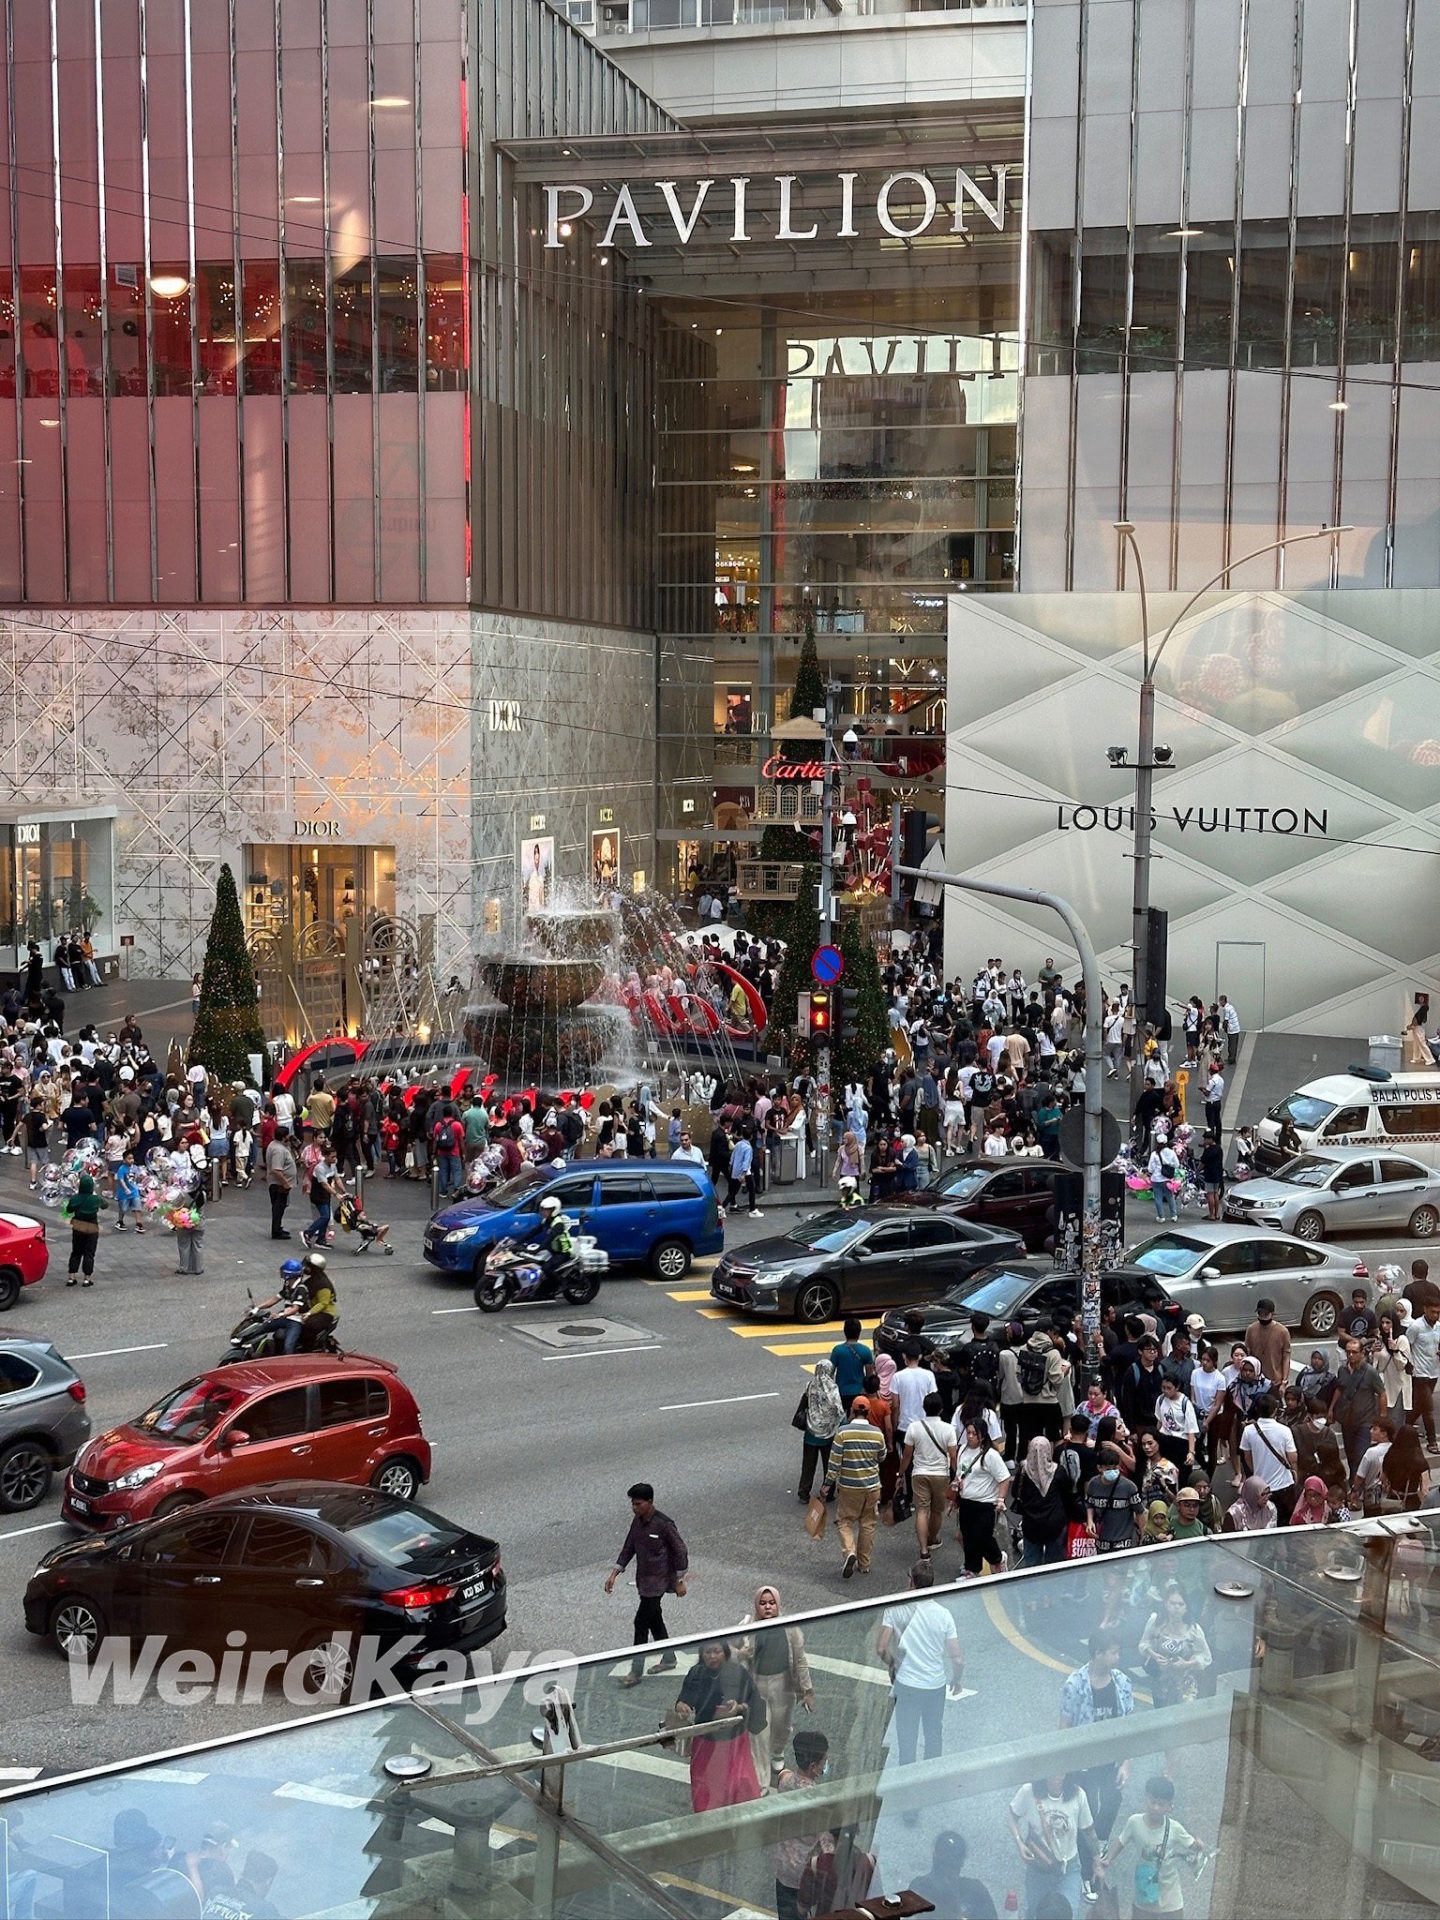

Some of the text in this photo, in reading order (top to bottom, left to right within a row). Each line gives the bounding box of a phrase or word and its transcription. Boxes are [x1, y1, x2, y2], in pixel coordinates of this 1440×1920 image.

[542, 164, 1010, 248] PAVILION
[294, 820, 341, 836] DIOR
[1173, 808, 1327, 834] VUITTON
[1372, 1091, 1402, 1102] BALAI
[1405, 1090, 1432, 1101] POLIS
